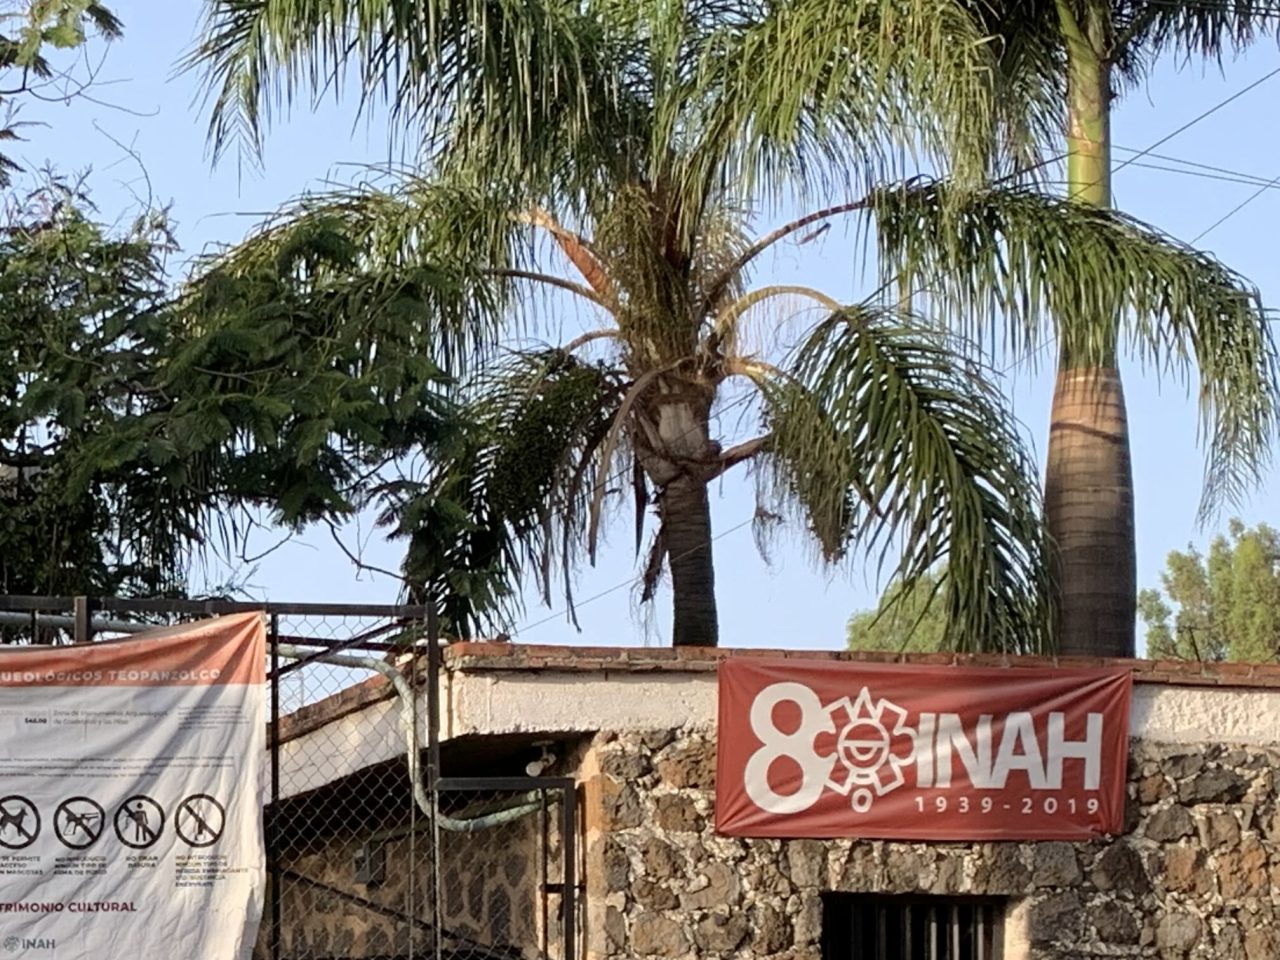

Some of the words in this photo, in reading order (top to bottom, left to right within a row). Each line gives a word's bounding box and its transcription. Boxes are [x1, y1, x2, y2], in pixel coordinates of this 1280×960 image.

[108, 667, 221, 682] TEOPANZOLCO
[915, 711, 1104, 791] INAH
[67, 902, 137, 913] CULTURAL
[21, 938, 56, 949] INAH
